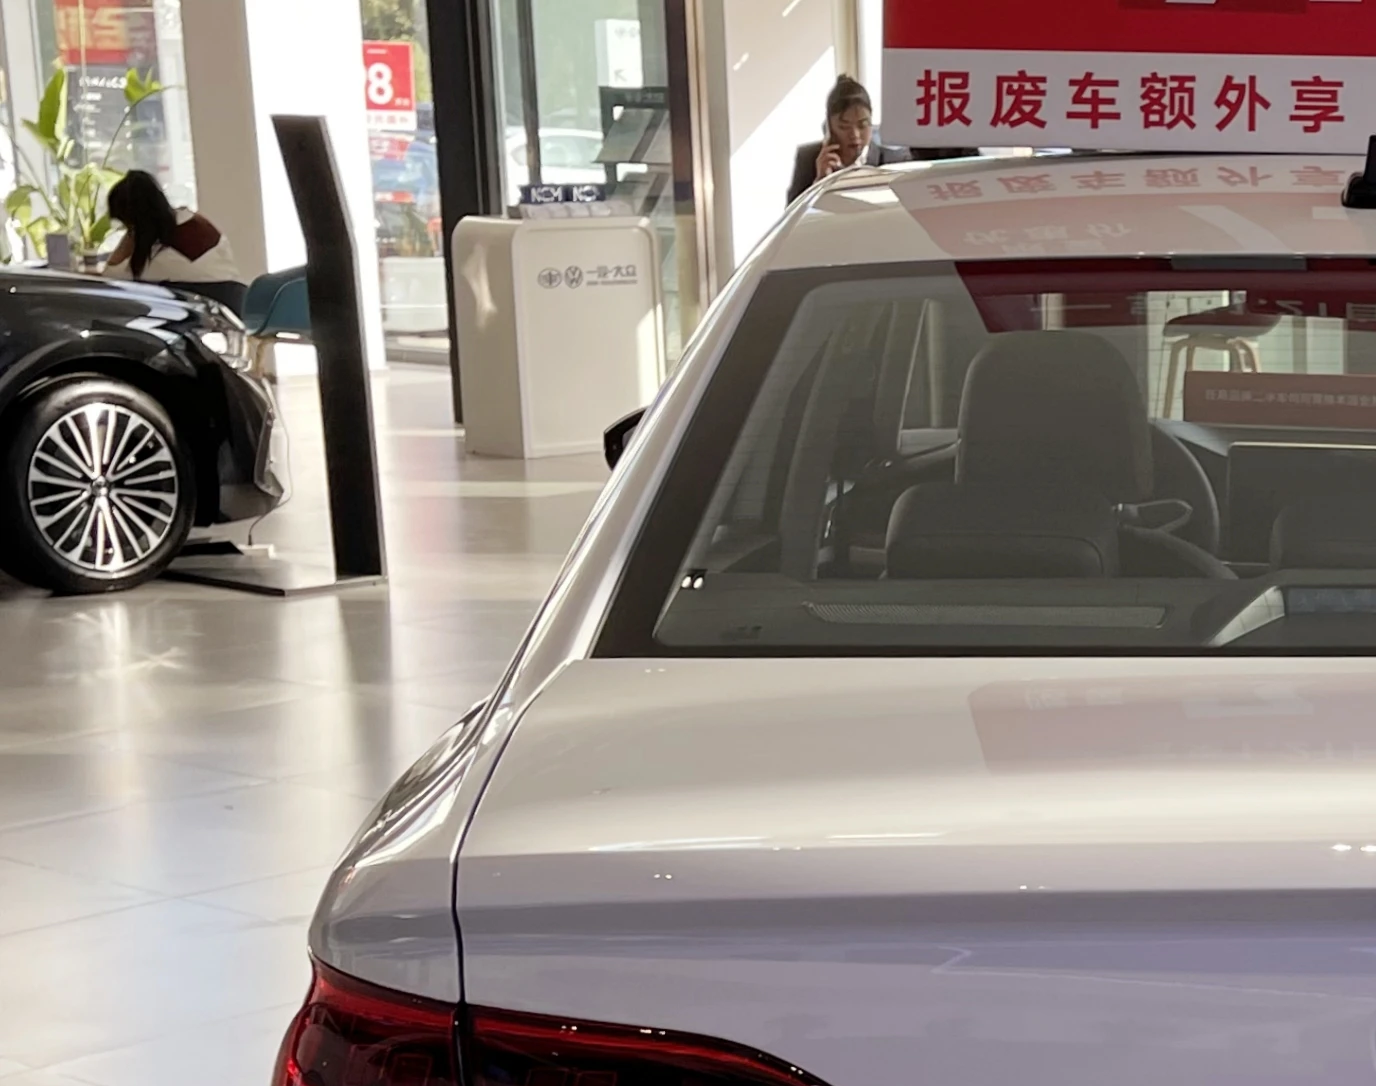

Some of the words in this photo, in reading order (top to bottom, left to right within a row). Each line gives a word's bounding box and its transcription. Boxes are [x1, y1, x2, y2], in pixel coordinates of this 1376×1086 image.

[915, 69, 1346, 134] 报废车额外享
